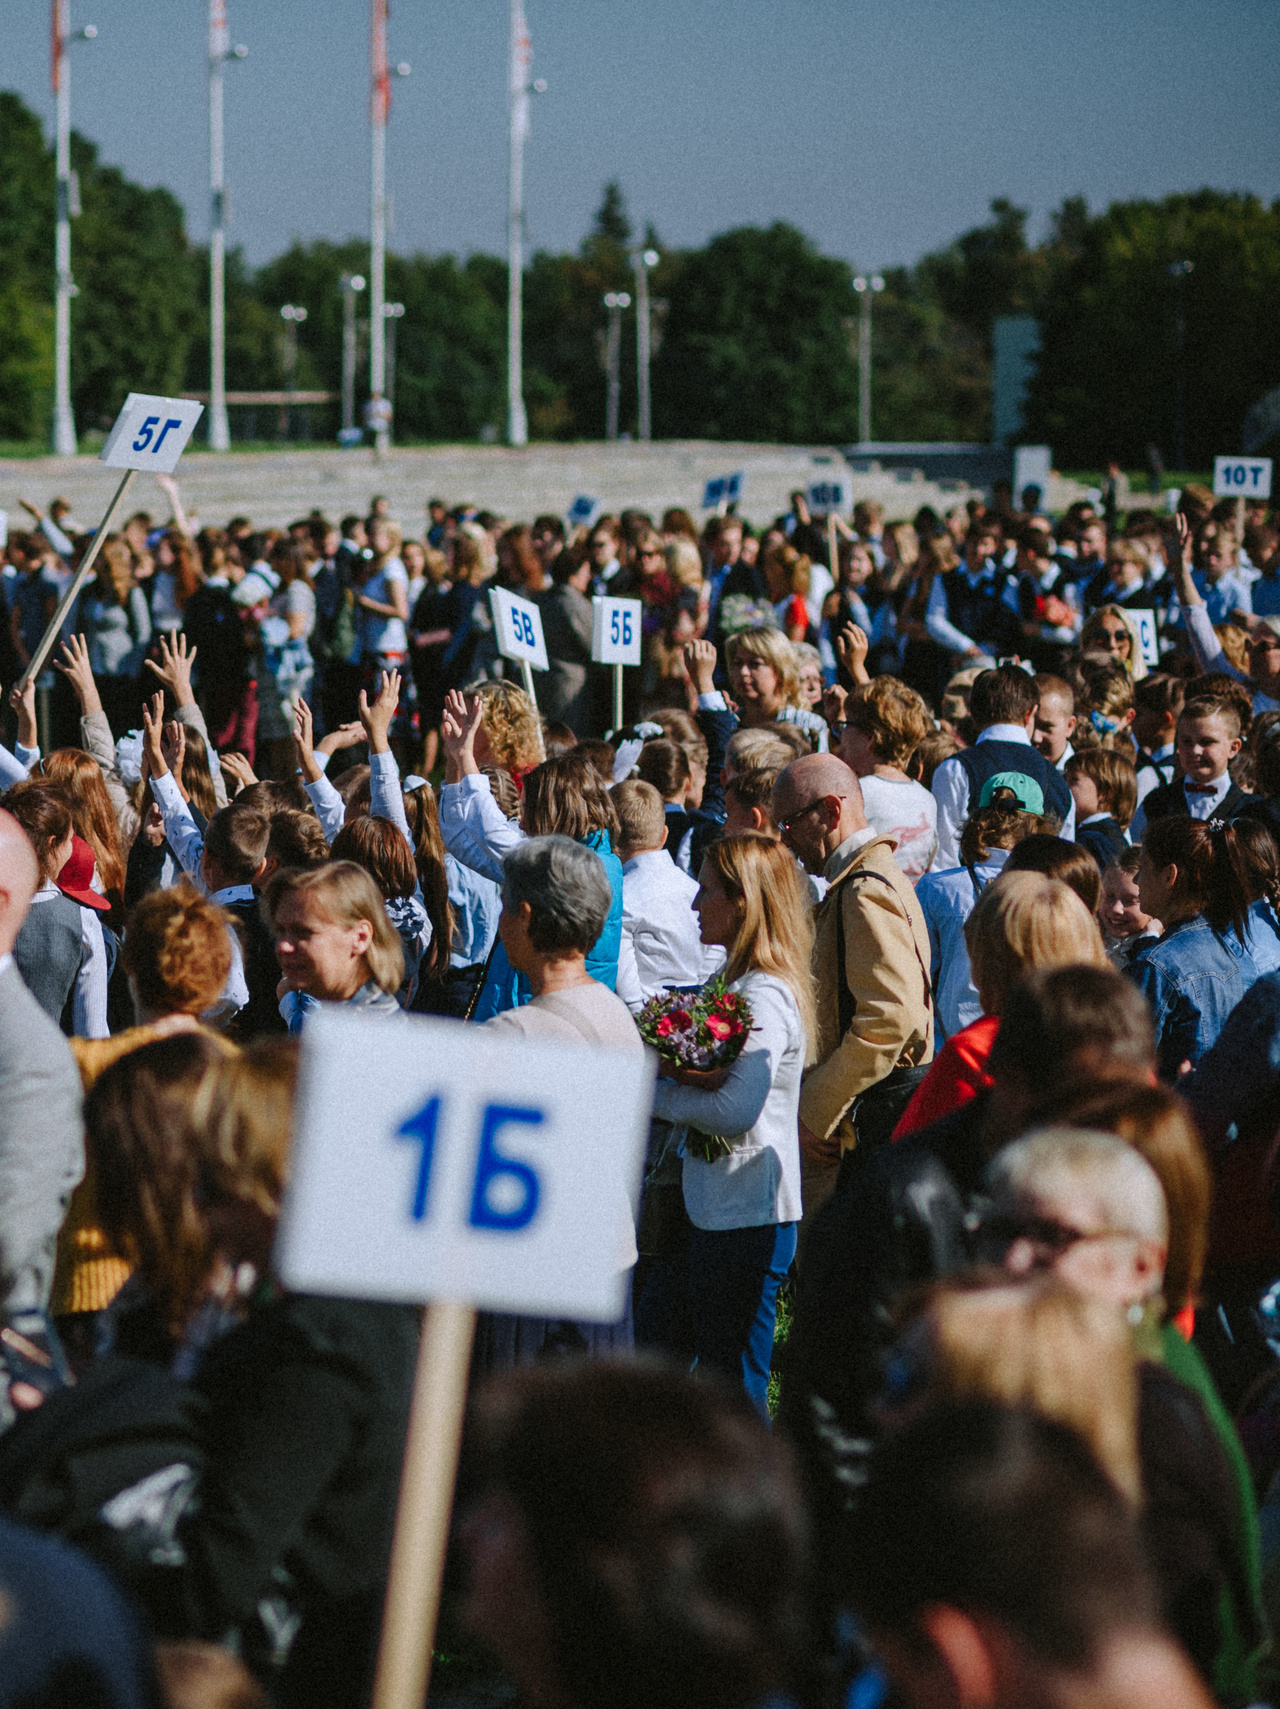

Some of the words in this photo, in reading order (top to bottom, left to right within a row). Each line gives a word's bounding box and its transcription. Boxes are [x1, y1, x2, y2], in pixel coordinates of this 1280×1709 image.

[132, 415, 183, 454] 5Г
[511, 606, 536, 648] 5В
[610, 609, 633, 646] 5Б
[392, 1095, 547, 1232] 1Б
